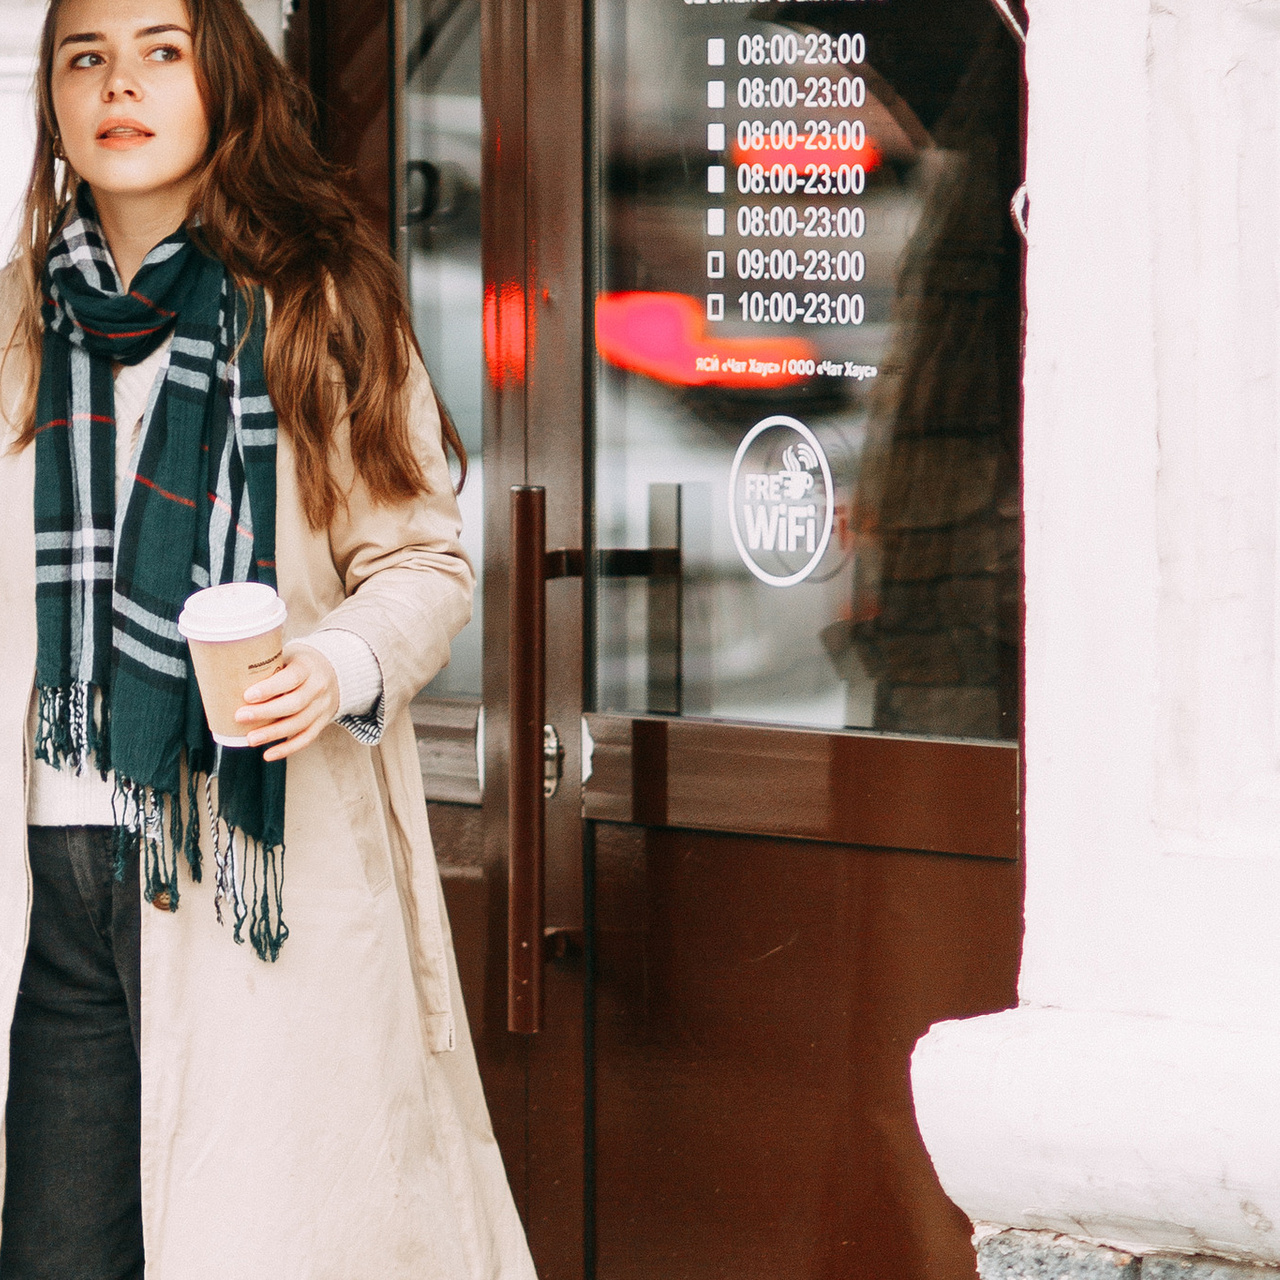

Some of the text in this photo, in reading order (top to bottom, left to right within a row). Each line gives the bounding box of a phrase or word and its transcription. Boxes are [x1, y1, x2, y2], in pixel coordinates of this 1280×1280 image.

[736, 33, 866, 65] 08:00-23:00
[736, 76, 866, 108] 08:00-23:00
[736, 120, 866, 151] 08:00-23:00
[736, 163, 866, 194] 08:00-23:00
[736, 206, 866, 238] 08:00-23:00
[736, 249, 866, 282] 09:00-23:00
[738, 291, 866, 325] 10:00-23:00
[787, 359, 815, 376] ООО
[743, 503, 816, 553] WiFi
